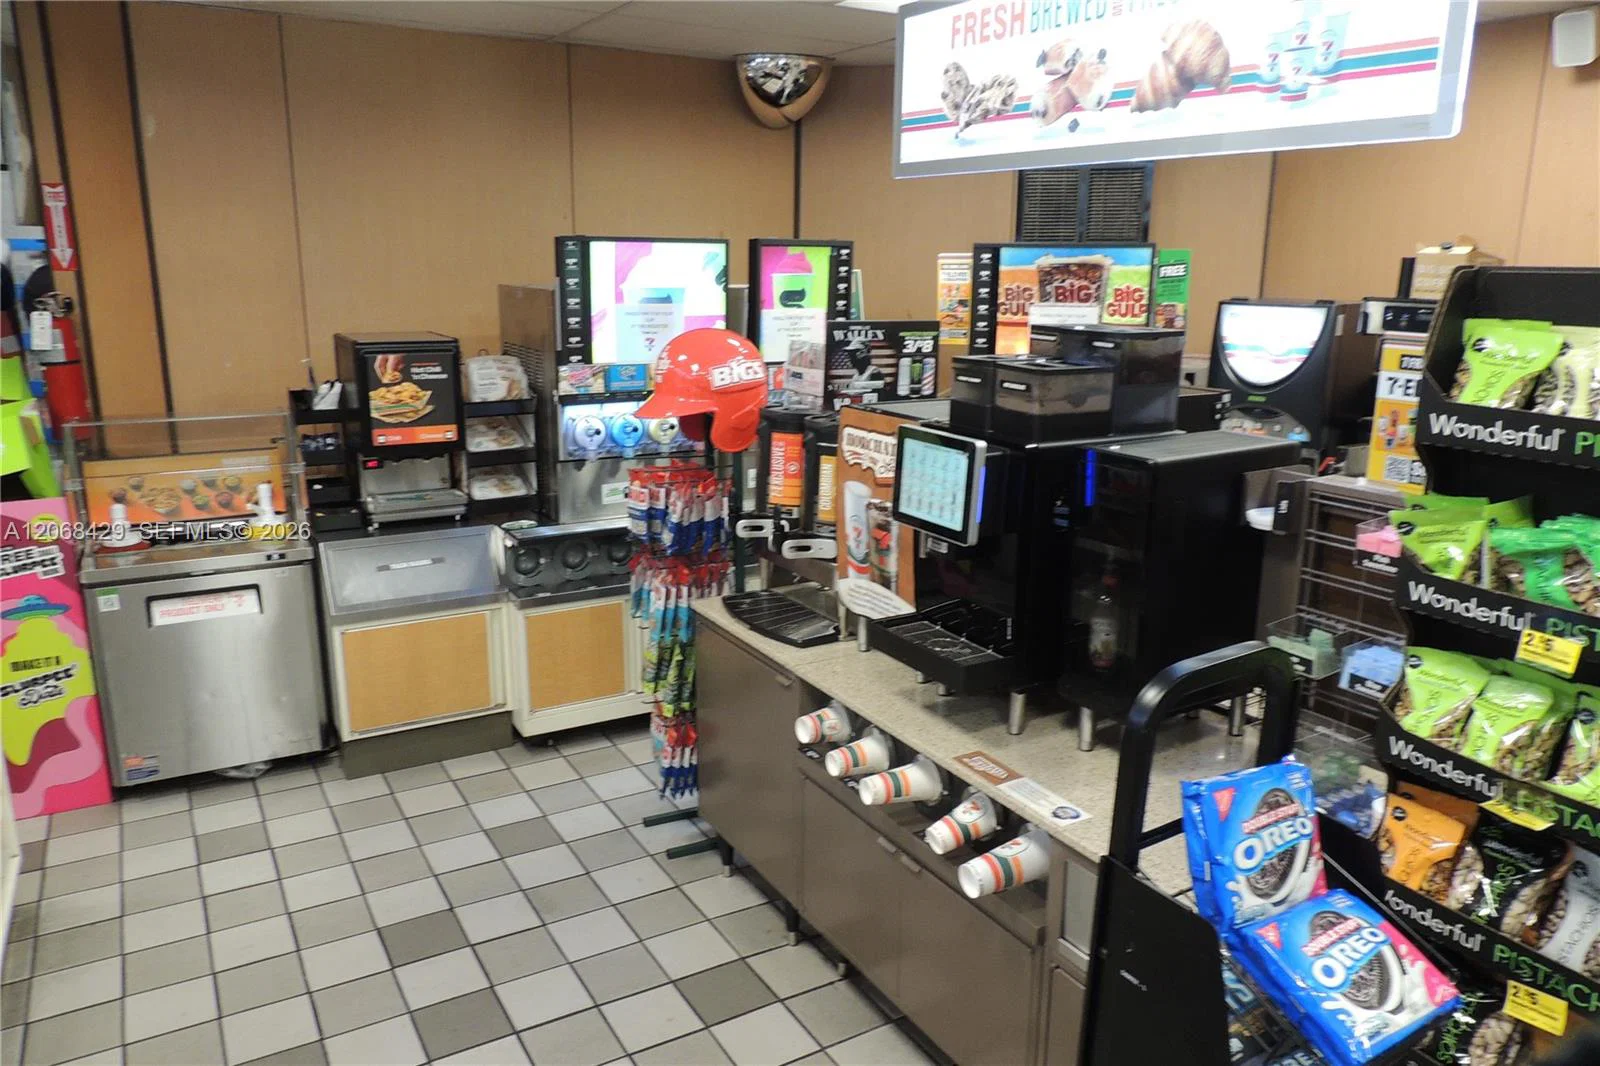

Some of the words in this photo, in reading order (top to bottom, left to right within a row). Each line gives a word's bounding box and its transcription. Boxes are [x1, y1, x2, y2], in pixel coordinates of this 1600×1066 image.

[951, 0, 1026, 49] FRESH
[1004, 286, 1033, 301] BIG
[1054, 283, 1094, 303] BIG
[1106, 301, 1148, 318] GULP
[1114, 285, 1144, 302] BIG
[1387, 376, 1418, 397] 7-E
[1429, 412, 1562, 452] Wonderful
[1574, 431, 1600, 458] PI
[1408, 581, 1533, 632] Wonderful
[1546, 617, 1600, 652] PIST
[1389, 736, 1503, 800] Wonderful
[1516, 788, 1600, 840] PISTA
[1234, 816, 1313, 871] OREO
[1312, 926, 1388, 990] OREO
[1493, 943, 1600, 1012] PISTACH
